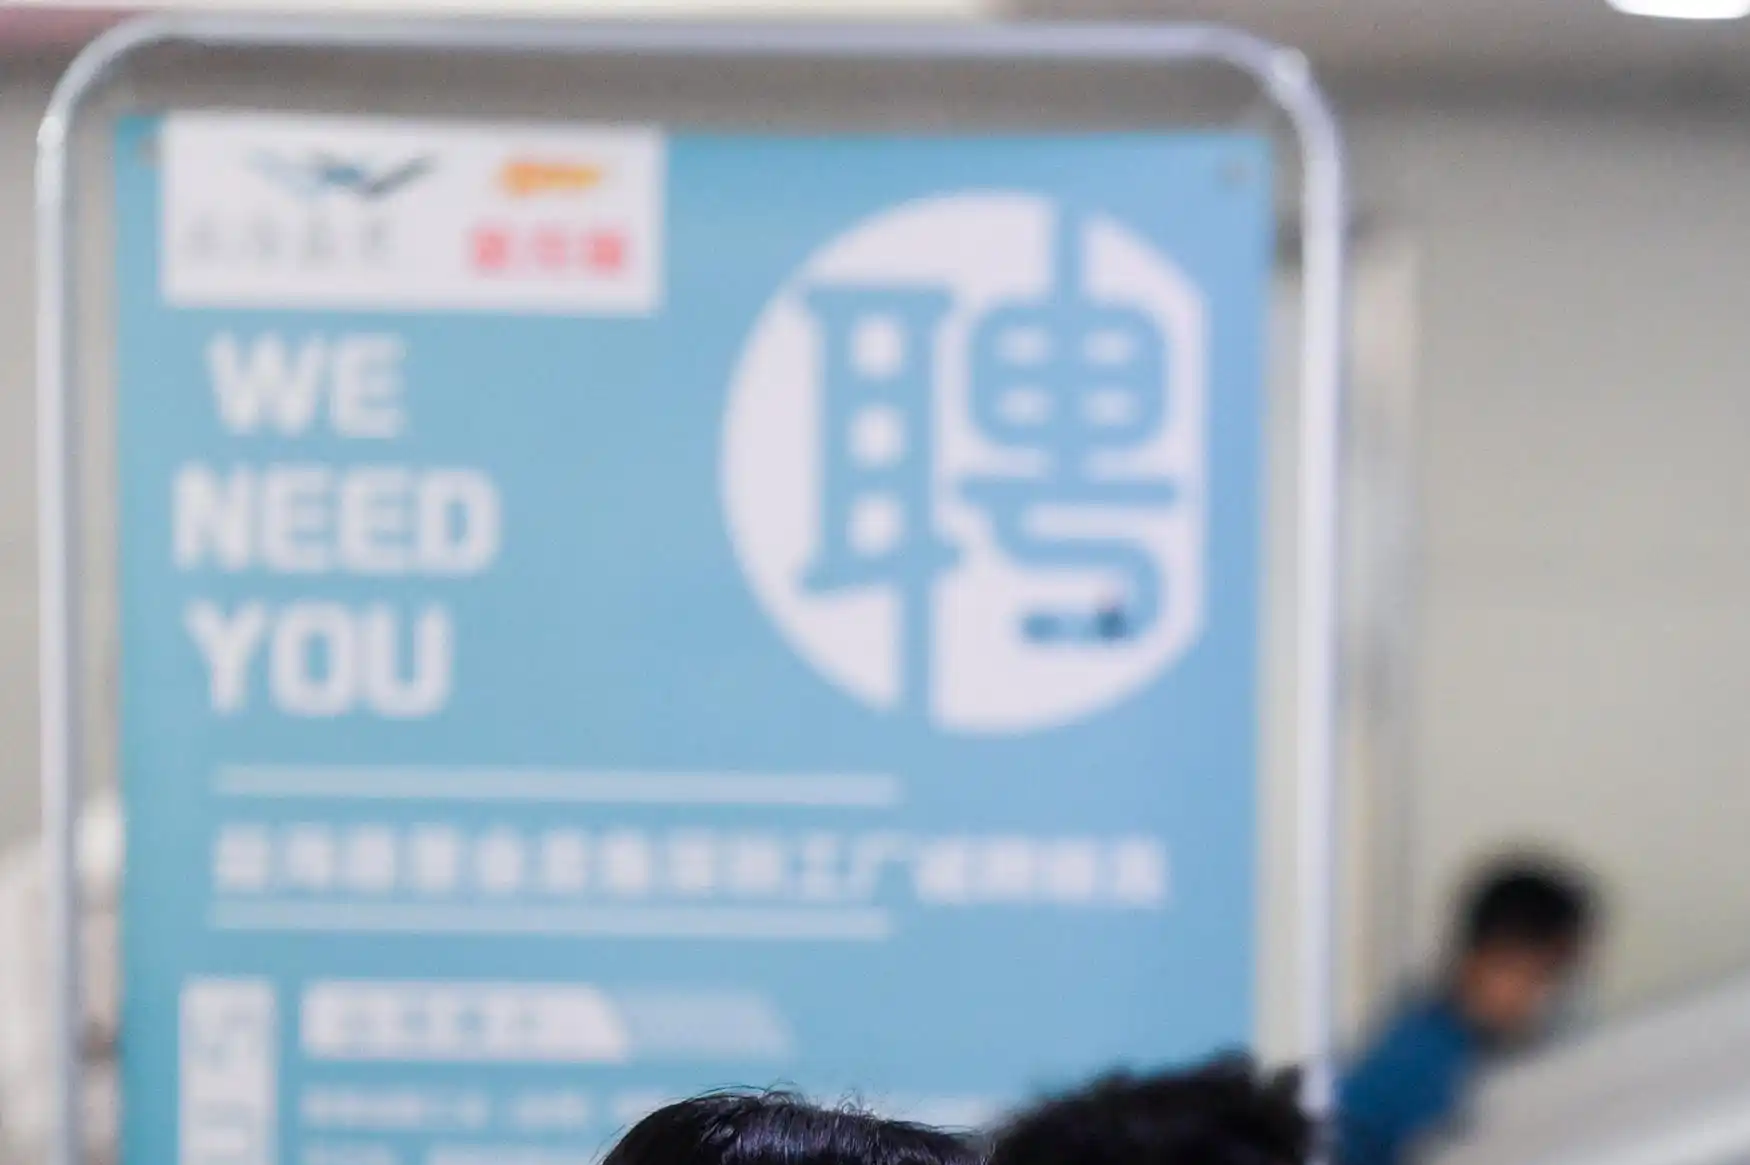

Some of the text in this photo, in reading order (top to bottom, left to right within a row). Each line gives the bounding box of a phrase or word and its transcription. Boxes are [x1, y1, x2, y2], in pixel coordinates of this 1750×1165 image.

[207, 332, 405, 437] WE
[775, 188, 1198, 725] 聘
[174, 464, 500, 575] NEED
[185, 600, 452, 718] YOU
